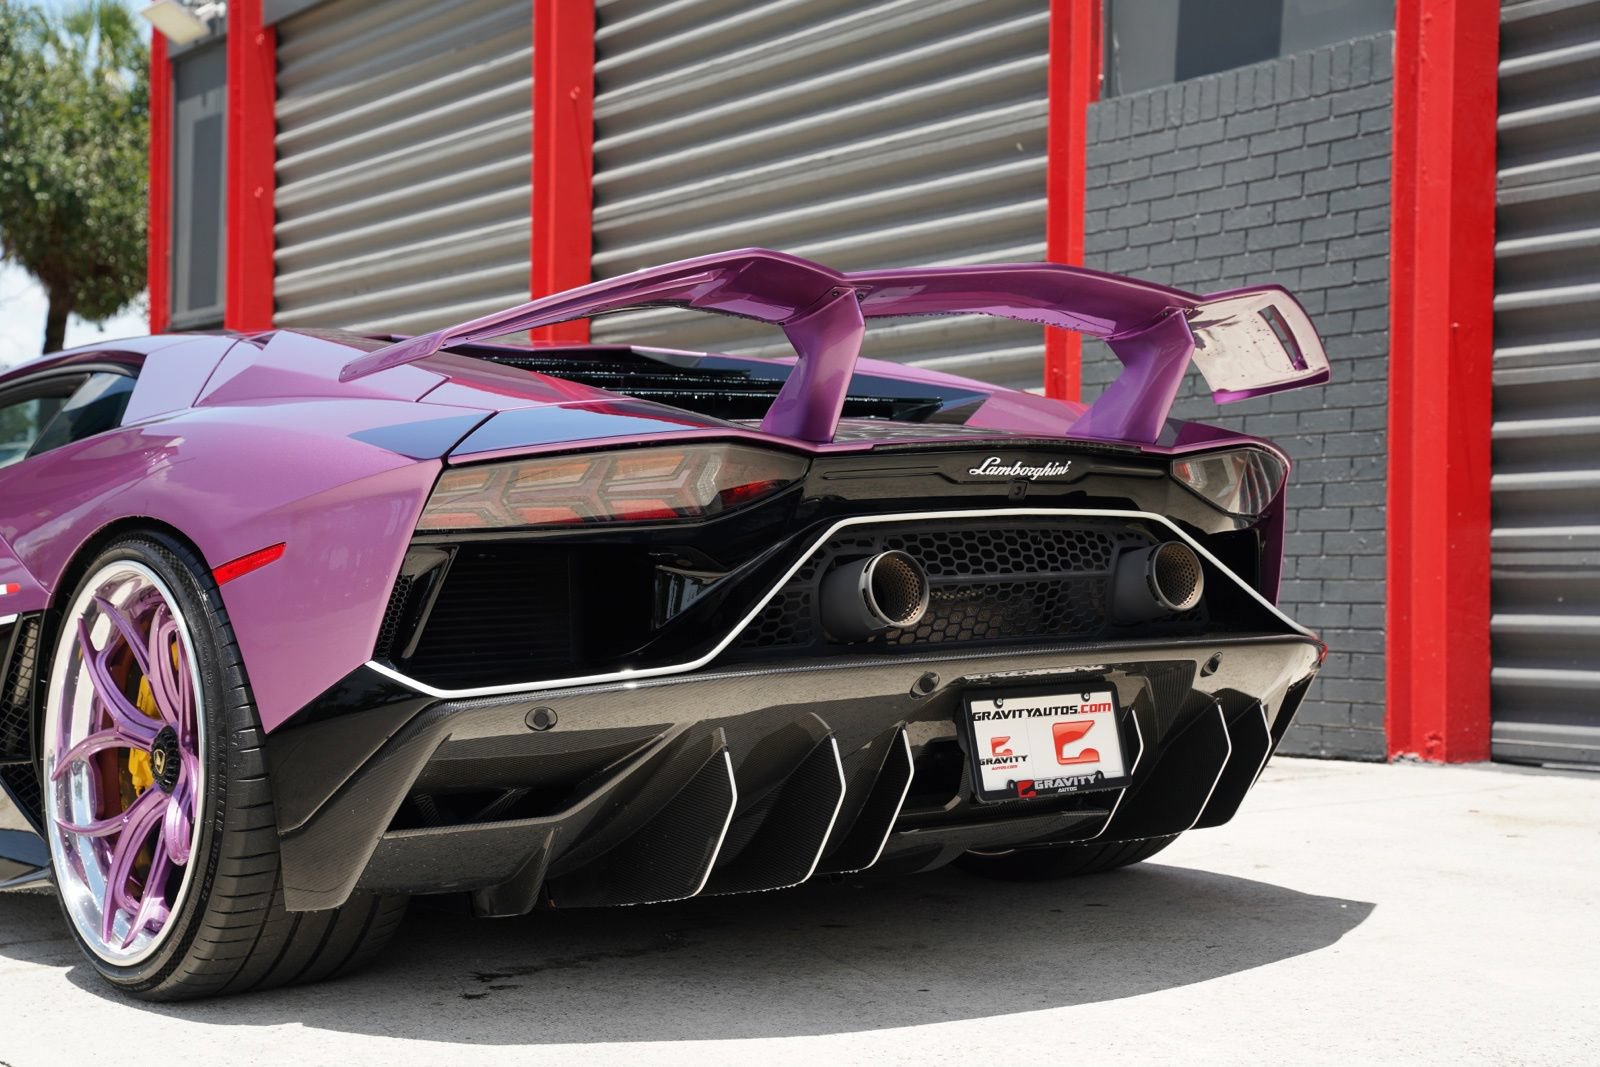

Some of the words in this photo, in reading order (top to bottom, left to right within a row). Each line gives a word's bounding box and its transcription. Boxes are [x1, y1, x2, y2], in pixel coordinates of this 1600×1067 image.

[969, 456, 1071, 480] Lamborghini
[980, 755, 1028, 766] GRAVITY
[1035, 775, 1097, 790] GRAVITY
